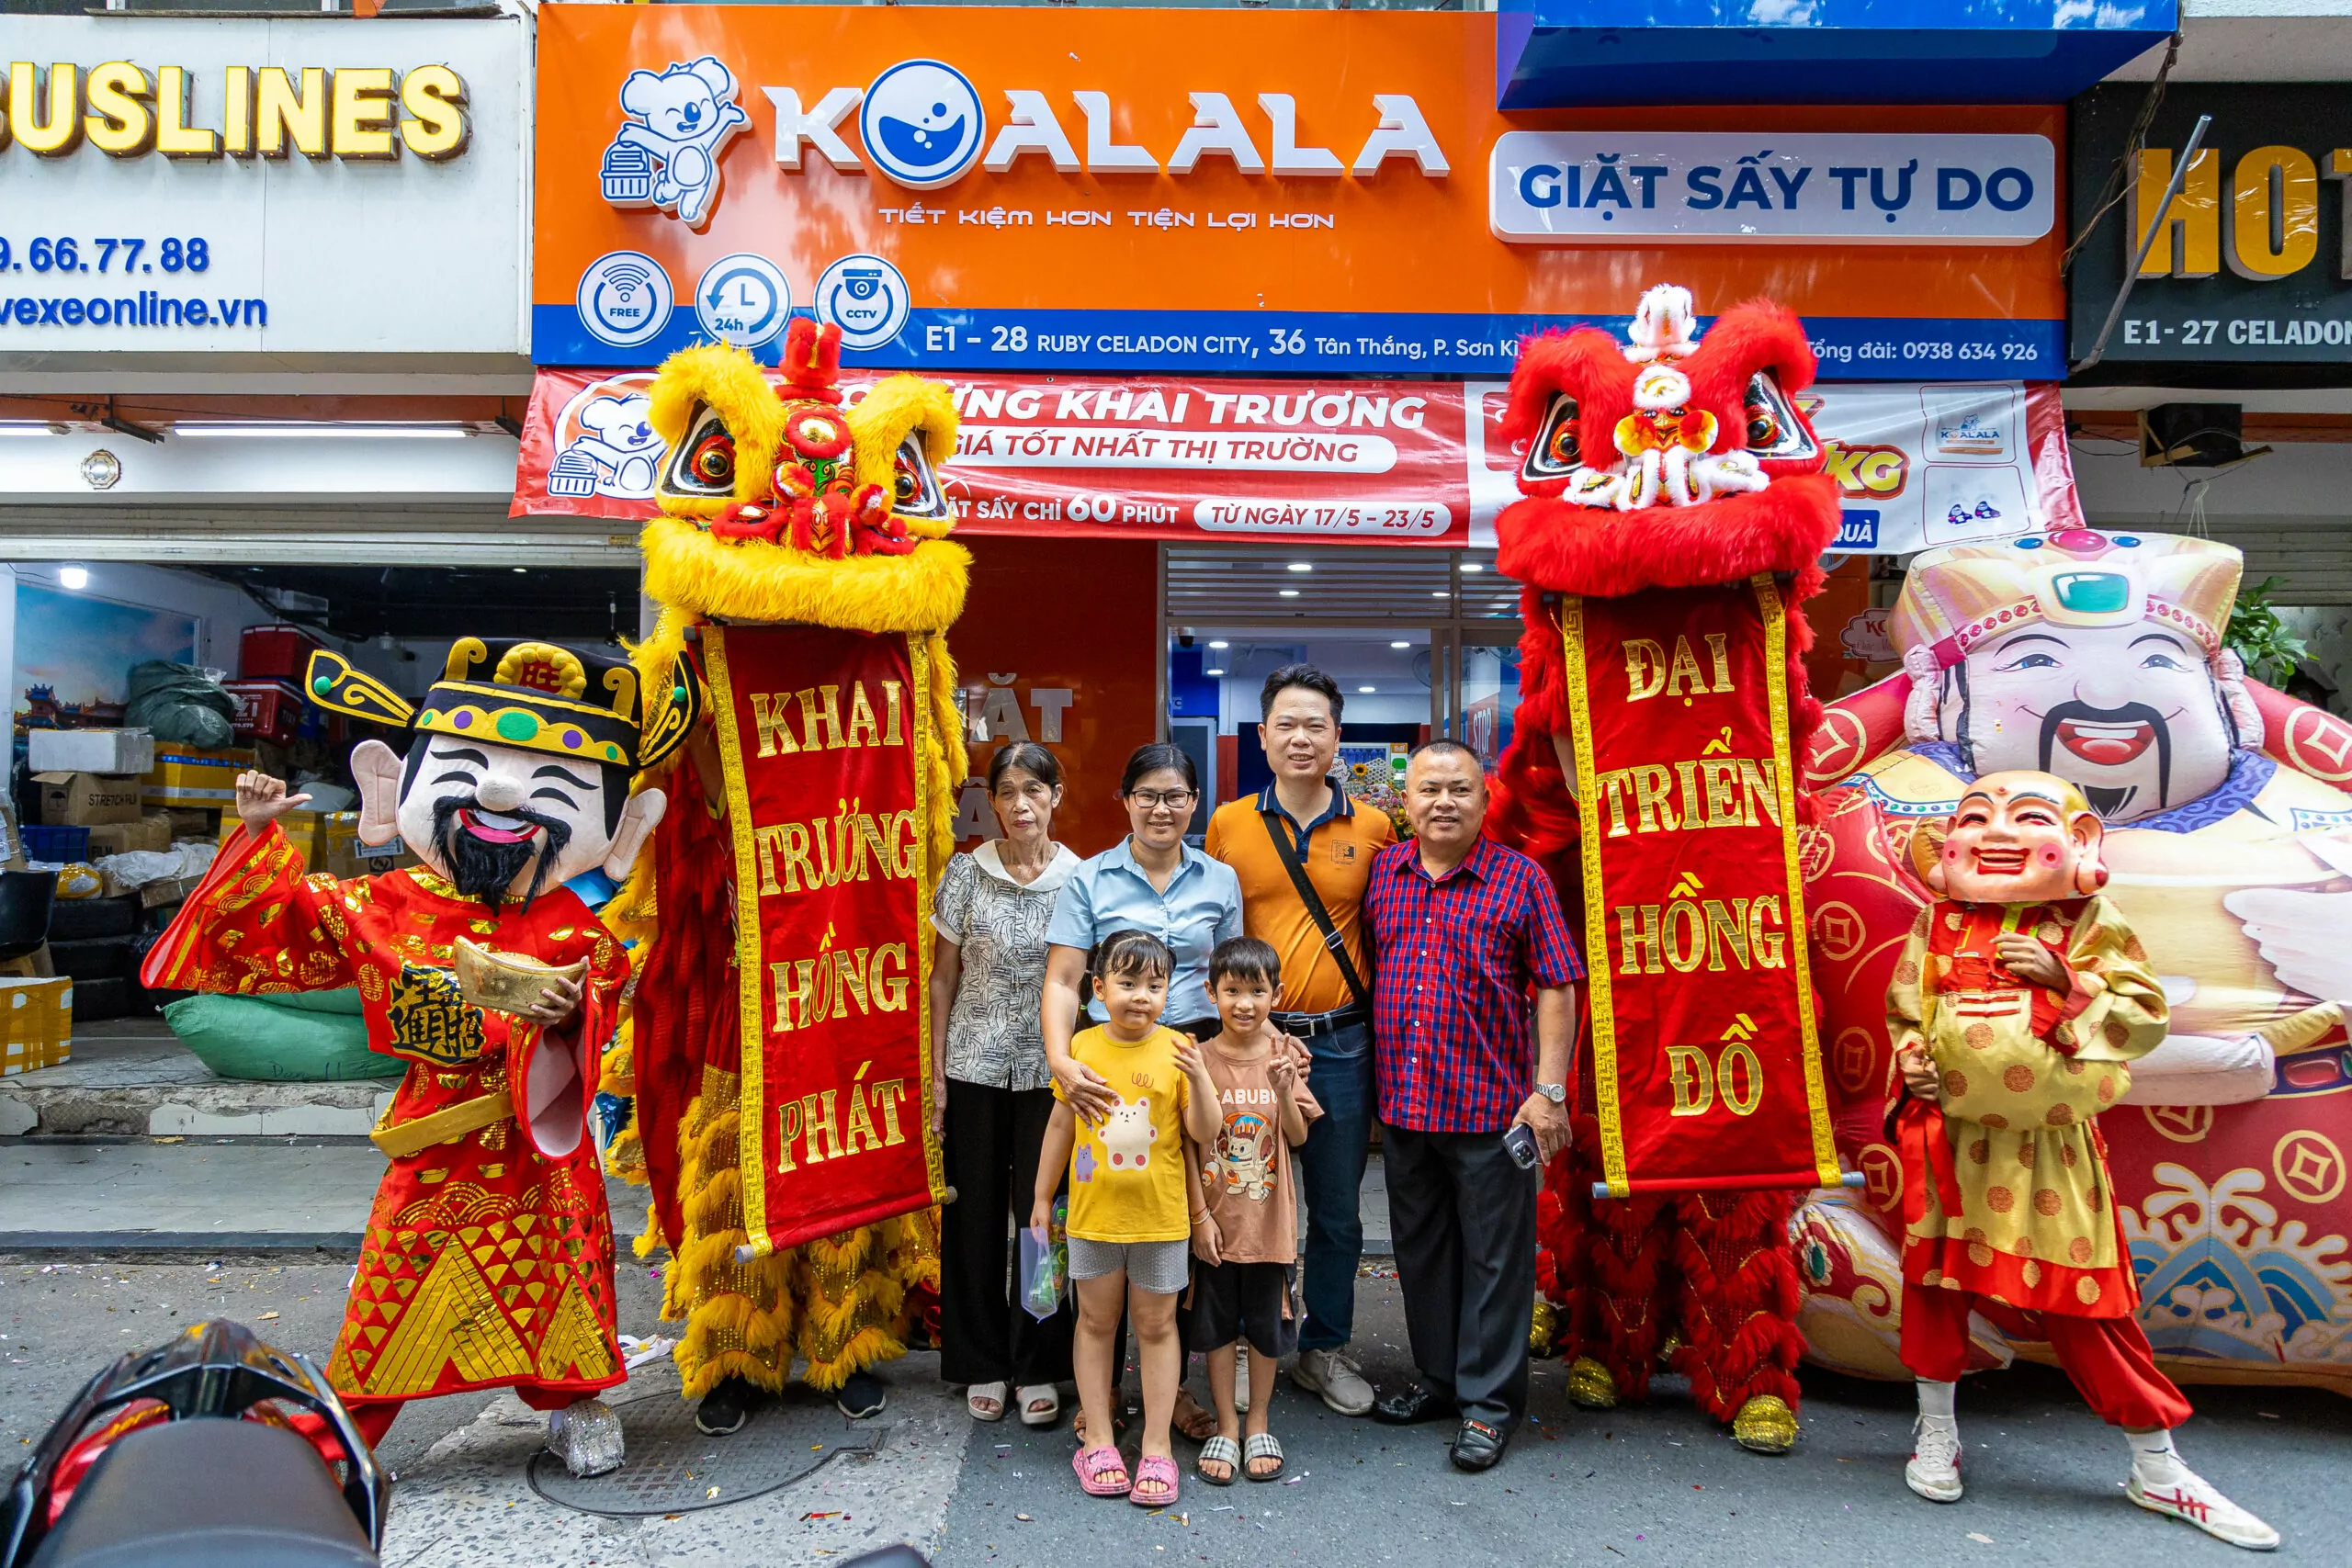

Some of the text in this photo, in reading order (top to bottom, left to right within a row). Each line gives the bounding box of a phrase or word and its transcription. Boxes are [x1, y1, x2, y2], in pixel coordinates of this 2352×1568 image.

[1519, 150, 2034, 223] GIẶT SẤY TỰ DO
[878, 201, 946, 225] TIẾT
[1046, 210, 1112, 226] HƠN
[1126, 208, 1195, 231] TIỆN
[1207, 212, 1257, 232] LỢI
[1269, 213, 1335, 229] HƠN
[2136, 144, 2352, 276] HO
[609, 308, 640, 318] FREE
[714, 318, 744, 332] 24h
[845, 309, 877, 319] CCTV
[925, 325, 956, 352] E1
[990, 325, 1029, 352] 28
[1036, 335, 1091, 353] RUBY
[1096, 335, 1197, 354] CELADON
[1203, 335, 1259, 359] CITY,
[1268, 328, 1306, 355] 36
[1314, 337, 1351, 356] Tân
[1356, 335, 1428, 360] Thắng,
[1433, 338, 1450, 356] P.
[1455, 338, 1495, 357] Sơn
[2181, 320, 2220, 344] 27
[1858, 341, 1897, 360] đài:
[1902, 342, 1954, 360] 0938
[1958, 343, 1996, 360] 634
[2001, 343, 2039, 361] 926
[1055, 388, 1191, 424] KHAI
[1204, 389, 1429, 430] TRƯƠNG
[1005, 428, 1067, 457] TỐT
[1071, 431, 1160, 457] NHẤT
[1168, 438, 1217, 465] THỊ
[1227, 436, 1359, 463] TRƯỜNG
[976, 494, 1019, 521] SẤY
[1023, 497, 1061, 522] CHỈ
[1066, 493, 1117, 523] 60
[1122, 502, 1180, 524] PHÚT
[1211, 503, 1242, 525] TỪ
[1244, 503, 1309, 526] NGÀY
[1314, 507, 1361, 529] 17/5
[1382, 508, 1435, 531] 23/5
[1622, 632, 1736, 707] ĐẠI
[751, 680, 908, 759] KHAI
[1596, 726, 1782, 839] TRIỂN
[1614, 870, 1787, 975] HỒNG
[1664, 1012, 1764, 1118] ĐỒ
[1219, 1088, 1280, 1105] ABUBU
[776, 1060, 906, 1175] PHÁT
